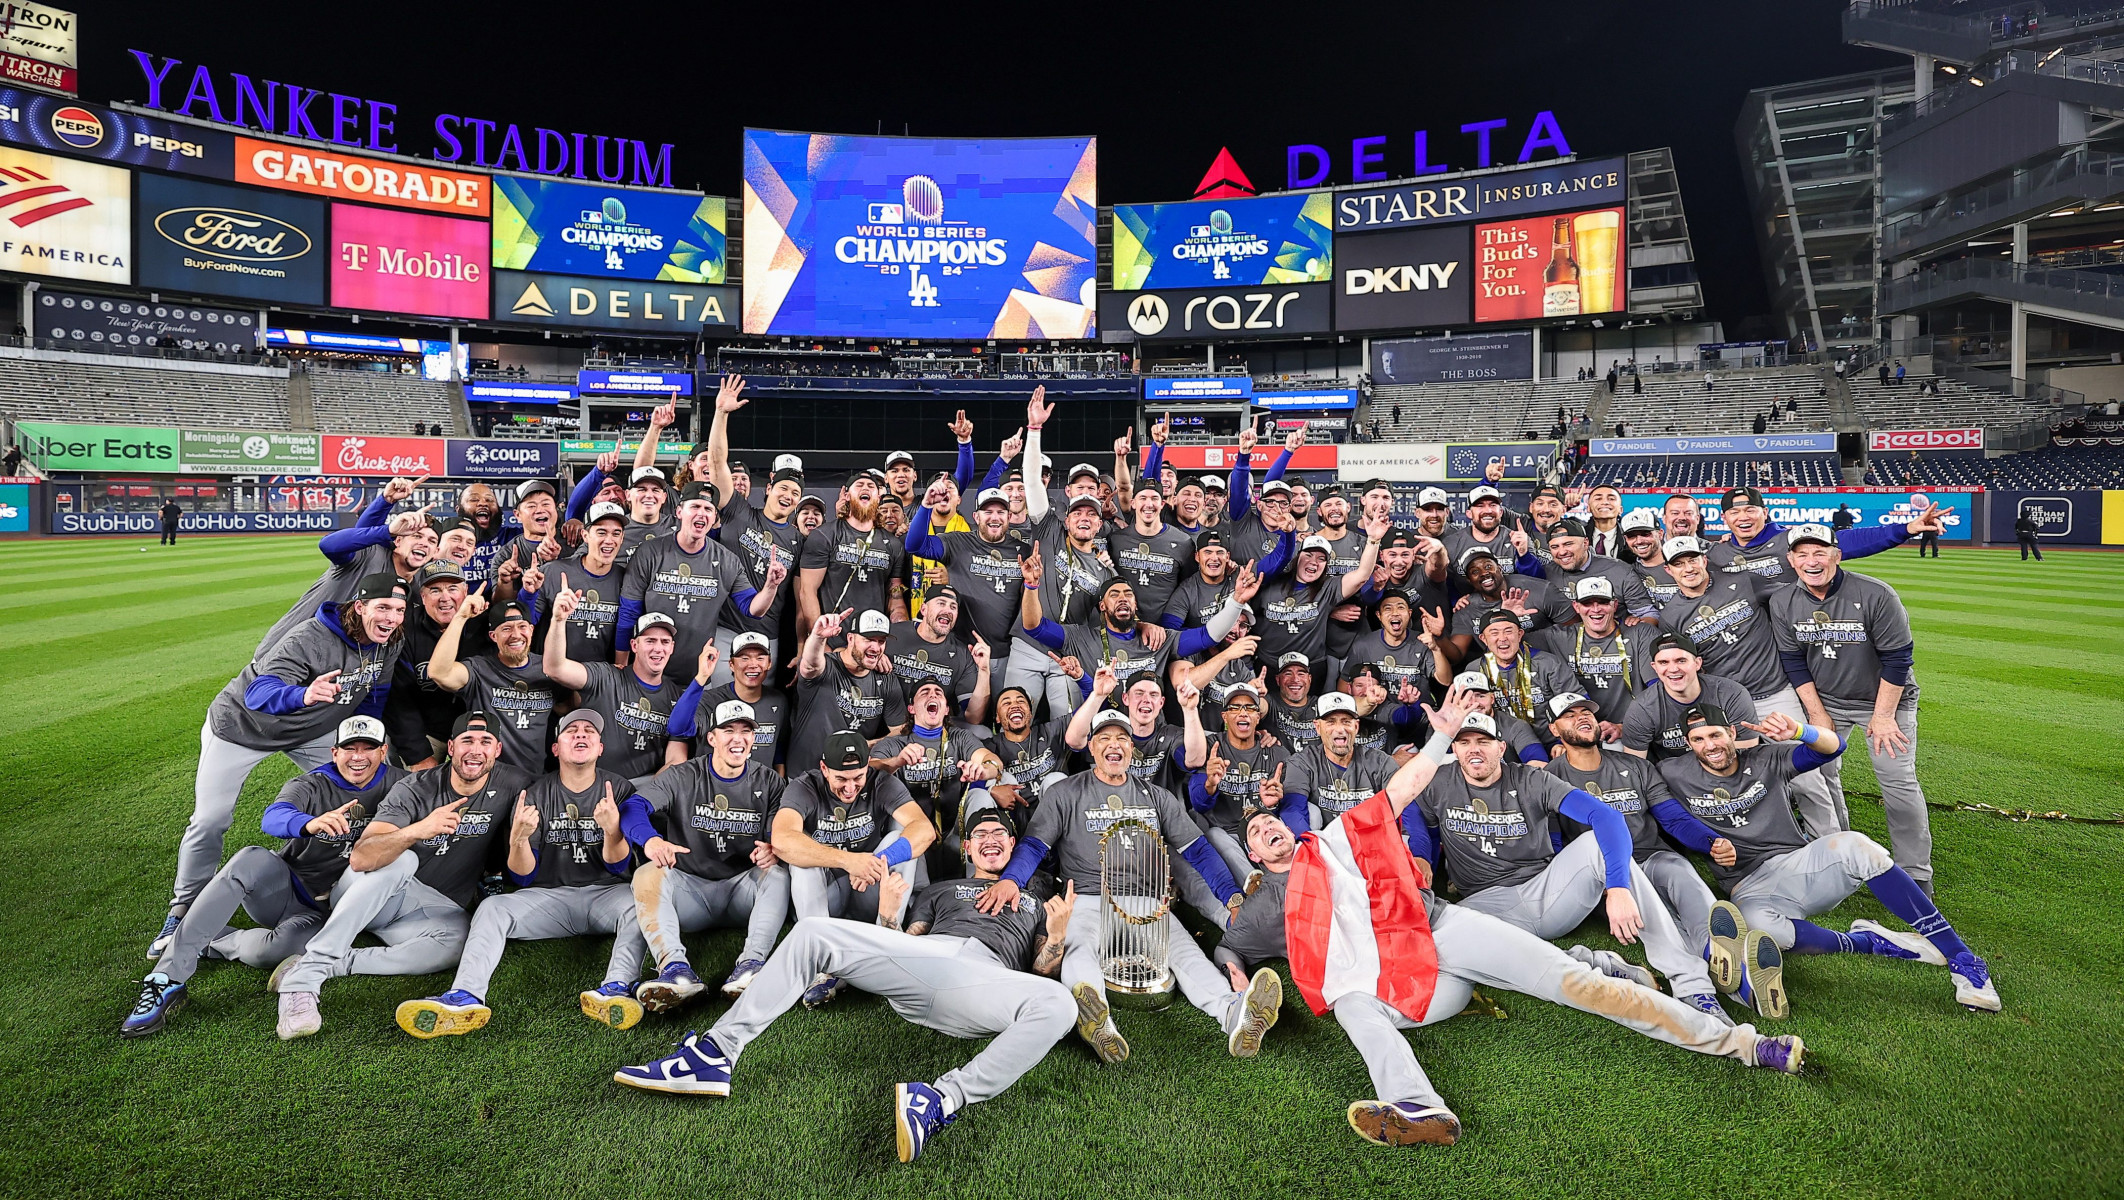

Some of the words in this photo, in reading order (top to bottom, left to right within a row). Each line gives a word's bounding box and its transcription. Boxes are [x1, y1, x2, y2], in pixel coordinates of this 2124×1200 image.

[6, 67, 62, 88] WATCHES
[128, 48, 399, 155] YANKEE
[434, 113, 676, 188] STADIUM
[55, 118, 101, 136] PEPSI
[134, 132, 204, 159] PEPSI
[1287, 109, 1572, 190] DELTA
[251, 149, 480, 209] GATORADE
[1339, 185, 1473, 228] STARR
[1484, 171, 1619, 204] INSURANCE
[183, 211, 286, 258] Ford
[573, 221, 613, 235] WORLD
[613, 224, 652, 236] SERIES
[856, 225, 919, 239] WORLD
[923, 226, 987, 240] SERIES
[1481, 226, 1529, 246] This
[561, 226, 664, 252] CHAMPIONS
[1184, 235, 1220, 245] WORLD
[1221, 234, 1258, 243] SERIES
[21, 243, 125, 269] AMERICA
[604, 245, 625, 271] LA
[834, 236, 1008, 266] CHAMPIONS
[1172, 239, 1270, 260] CHAMPIONS
[1481, 242, 1539, 263] Bud's
[183, 256, 286, 280] BuyFordNow.com
[376, 246, 481, 283] Mobile
[880, 265, 900, 276] 20
[942, 265, 963, 277] 24
[1213, 256, 1232, 280] LA
[1481, 265, 1518, 281] For
[908, 264, 941, 308] LA
[1345, 260, 1459, 296] DKNY
[1481, 281, 1527, 298] You.
[569, 286, 727, 324] DELTA
[1184, 291, 1300, 331] razr
[106, 315, 131, 328] New
[130, 318, 155, 332] York
[1440, 370, 1464, 379] THE
[1467, 367, 1497, 378] BOSS
[541, 416, 581, 427] TERRACE
[1309, 419, 1346, 428] TERRACE
[184, 431, 241, 445] Morningside
[270, 434, 316, 446] Workmen's
[564, 441, 595, 450] bet365
[1616, 442, 1657, 451] FANDUEL
[1690, 441, 1734, 449] FANDUEL
[1769, 439, 1816, 447] FANDUEL
[1871, 430, 1981, 449] Reebok
[103, 438, 173, 460] Eats
[290, 444, 316, 455] Circle
[489, 447, 540, 465] coupa
[664, 443, 693, 452] bet365
[338, 441, 431, 475] Chick-fil-A
[1226, 453, 1269, 462] TOOTA
[1379, 458, 1420, 466] AMERICA
[190, 464, 312, 474] WWW.CASSENACARE.COM
[465, 465, 484, 473] Make
[484, 465, 512, 475] Margins
[17, 476, 36, 484] BUDS
[62, 514, 155, 532] StubHub
[178, 513, 247, 531] tubHub
[253, 512, 333, 530] StubHub
[1769, 507, 1863, 523] CHAMPIOS
[972, 555, 1001, 568] WORLD
[1119, 558, 1174, 574] CHAMPIONS
[1120, 550, 1147, 562] WORLD
[1147, 554, 1174, 565] SERIES
[654, 572, 691, 586] WORLD
[689, 575, 718, 588] SERIES
[994, 577, 1006, 593] LA
[1138, 569, 1150, 586] LA
[652, 583, 718, 598] CHAMPIONS
[677, 594, 691, 614] LA
[1267, 602, 1292, 613] WORLD
[1685, 615, 1717, 635] WORLD
[1716, 598, 1749, 619] SERIES
[1690, 605, 1754, 644] CHAMPIONS
[587, 621, 599, 639] LA
[1287, 620, 1299, 634] LA
[1792, 621, 1830, 632] WORLD
[1830, 622, 1864, 632] SERIES
[1720, 630, 1739, 645] LA
[1795, 630, 1867, 642] CHAMPIONS
[1821, 641, 1838, 659] LA
[893, 654, 925, 670] WORLD
[925, 663, 954, 676] SERIES
[1593, 674, 1609, 689] LA
[492, 687, 529, 700] WORLD
[529, 689, 553, 700] SERIES
[490, 697, 553, 710] CHAMPIONS
[516, 709, 529, 730] LA
[726, 809, 763, 822] SERIES
[1084, 809, 1123, 820] WORLD
[1124, 807, 1158, 818] SERIES
[1446, 808, 1487, 823] WORLD
[1487, 811, 1525, 824] SERIES
[1727, 813, 1750, 829] LA
[548, 819, 577, 831] WORLD
[1445, 819, 1528, 837] CHAMPIONS
[714, 832, 727, 853] LA
[1480, 836, 1498, 858] LA
[571, 842, 589, 864] LA
